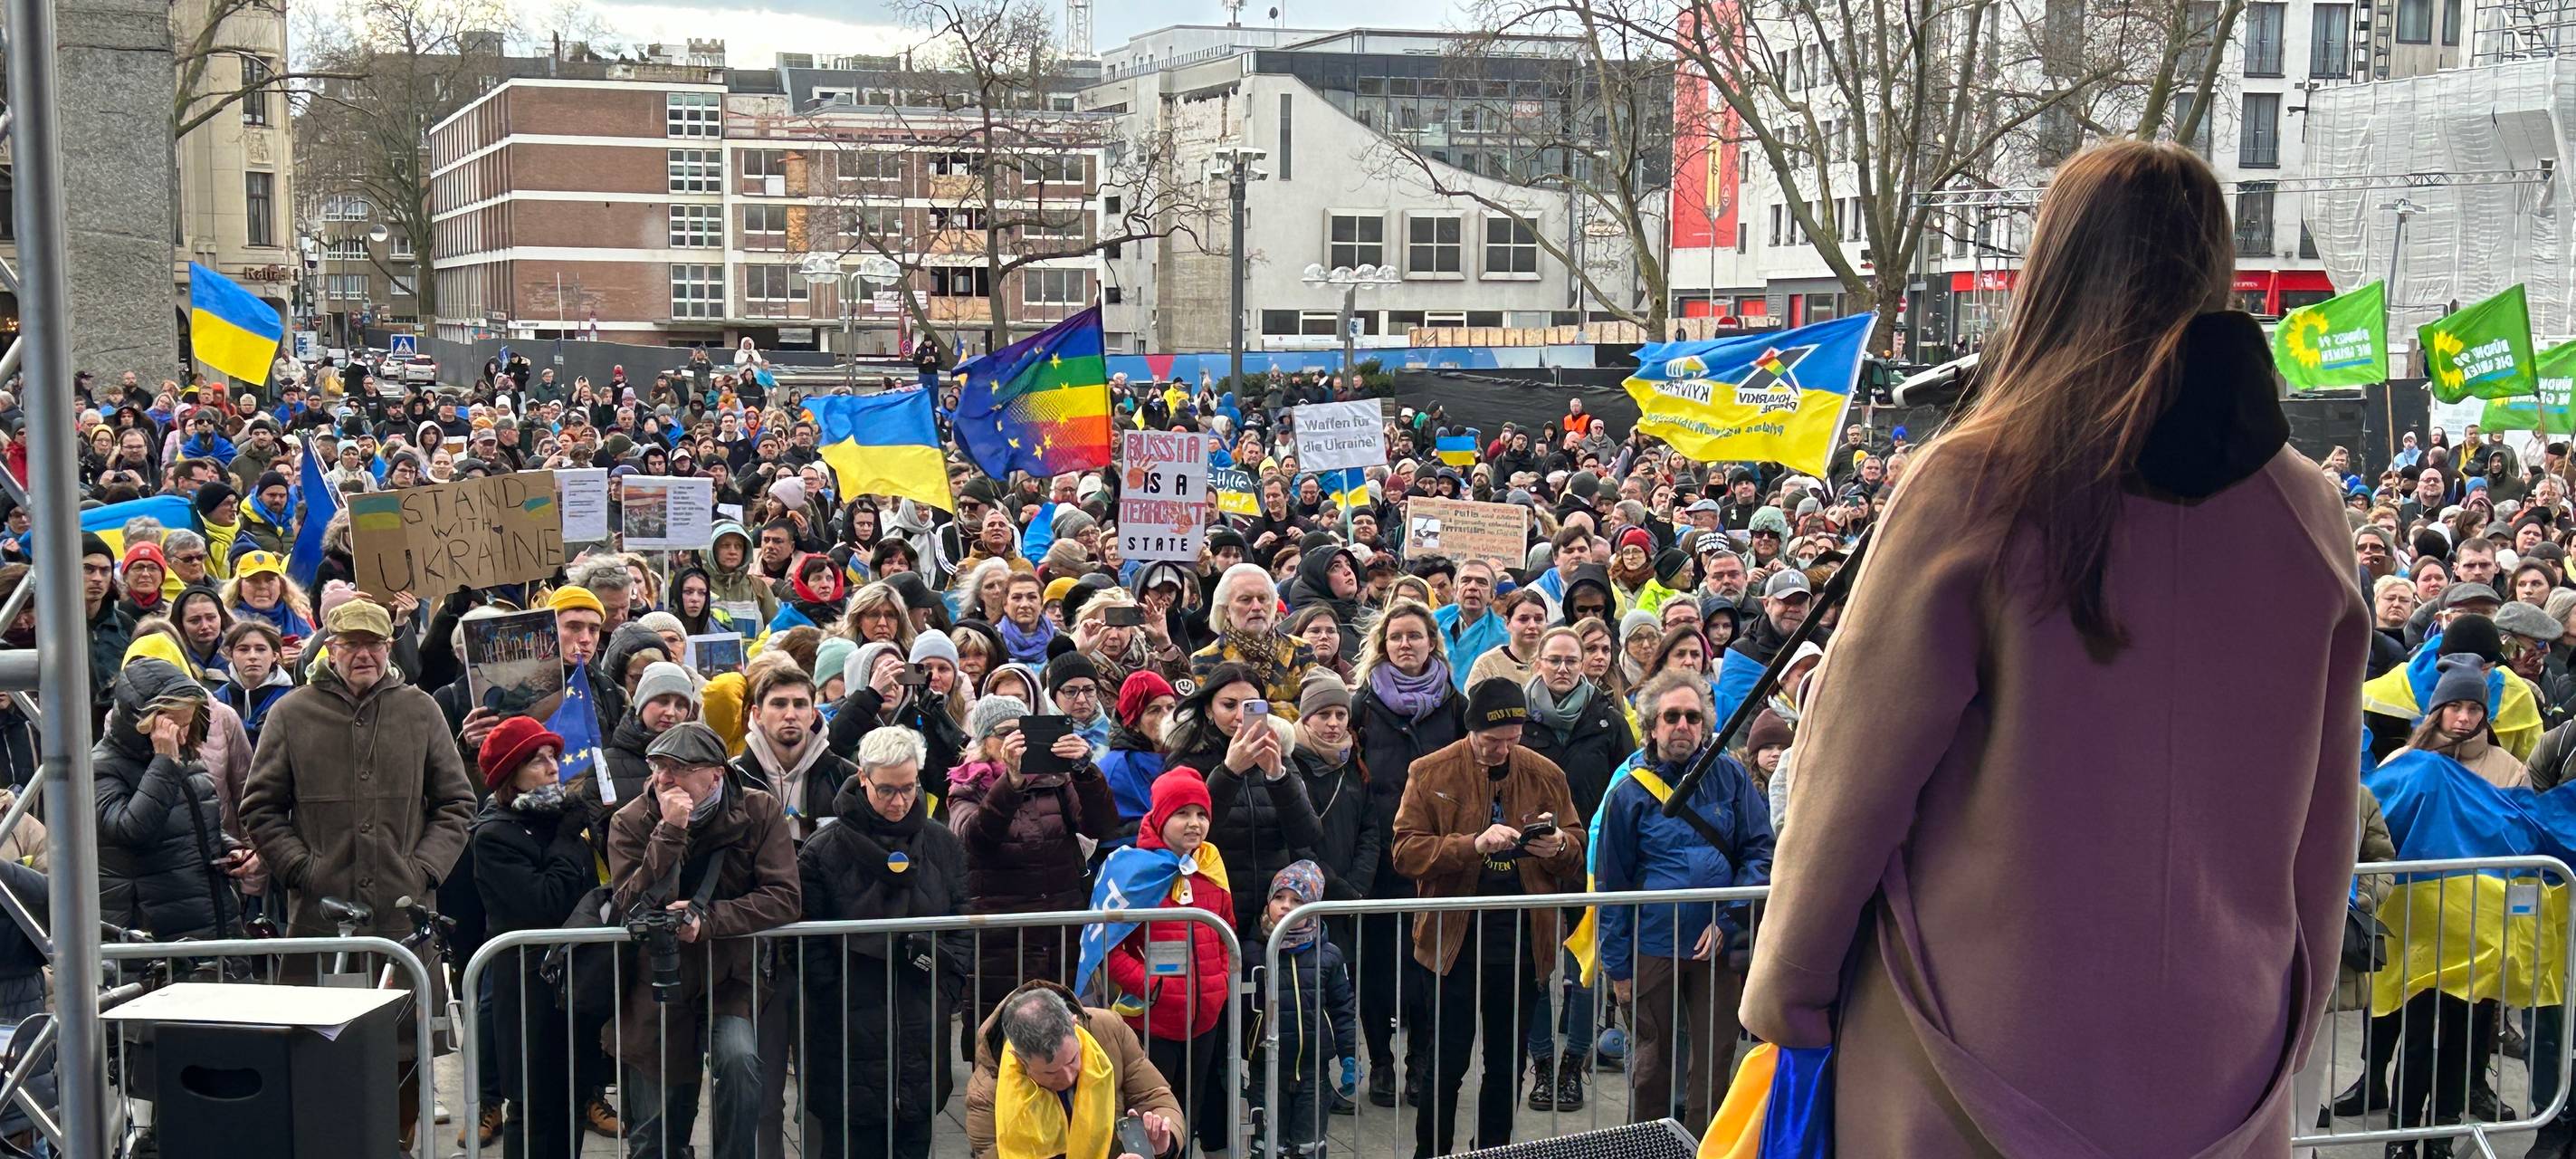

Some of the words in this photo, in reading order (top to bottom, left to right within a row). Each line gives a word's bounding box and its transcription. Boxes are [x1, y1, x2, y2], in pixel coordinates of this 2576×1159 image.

[1304, 417, 1350, 431] Waffen
[1126, 434, 1200, 464] RUSSIA
[1303, 440, 1322, 454] die
[1143, 472, 1161, 493] IS
[1176, 473, 1188, 495] A
[402, 477, 527, 525] STAND
[431, 518, 492, 539] WITH
[1128, 537, 1188, 552] STATE
[377, 525, 562, 593] UKRAINE
